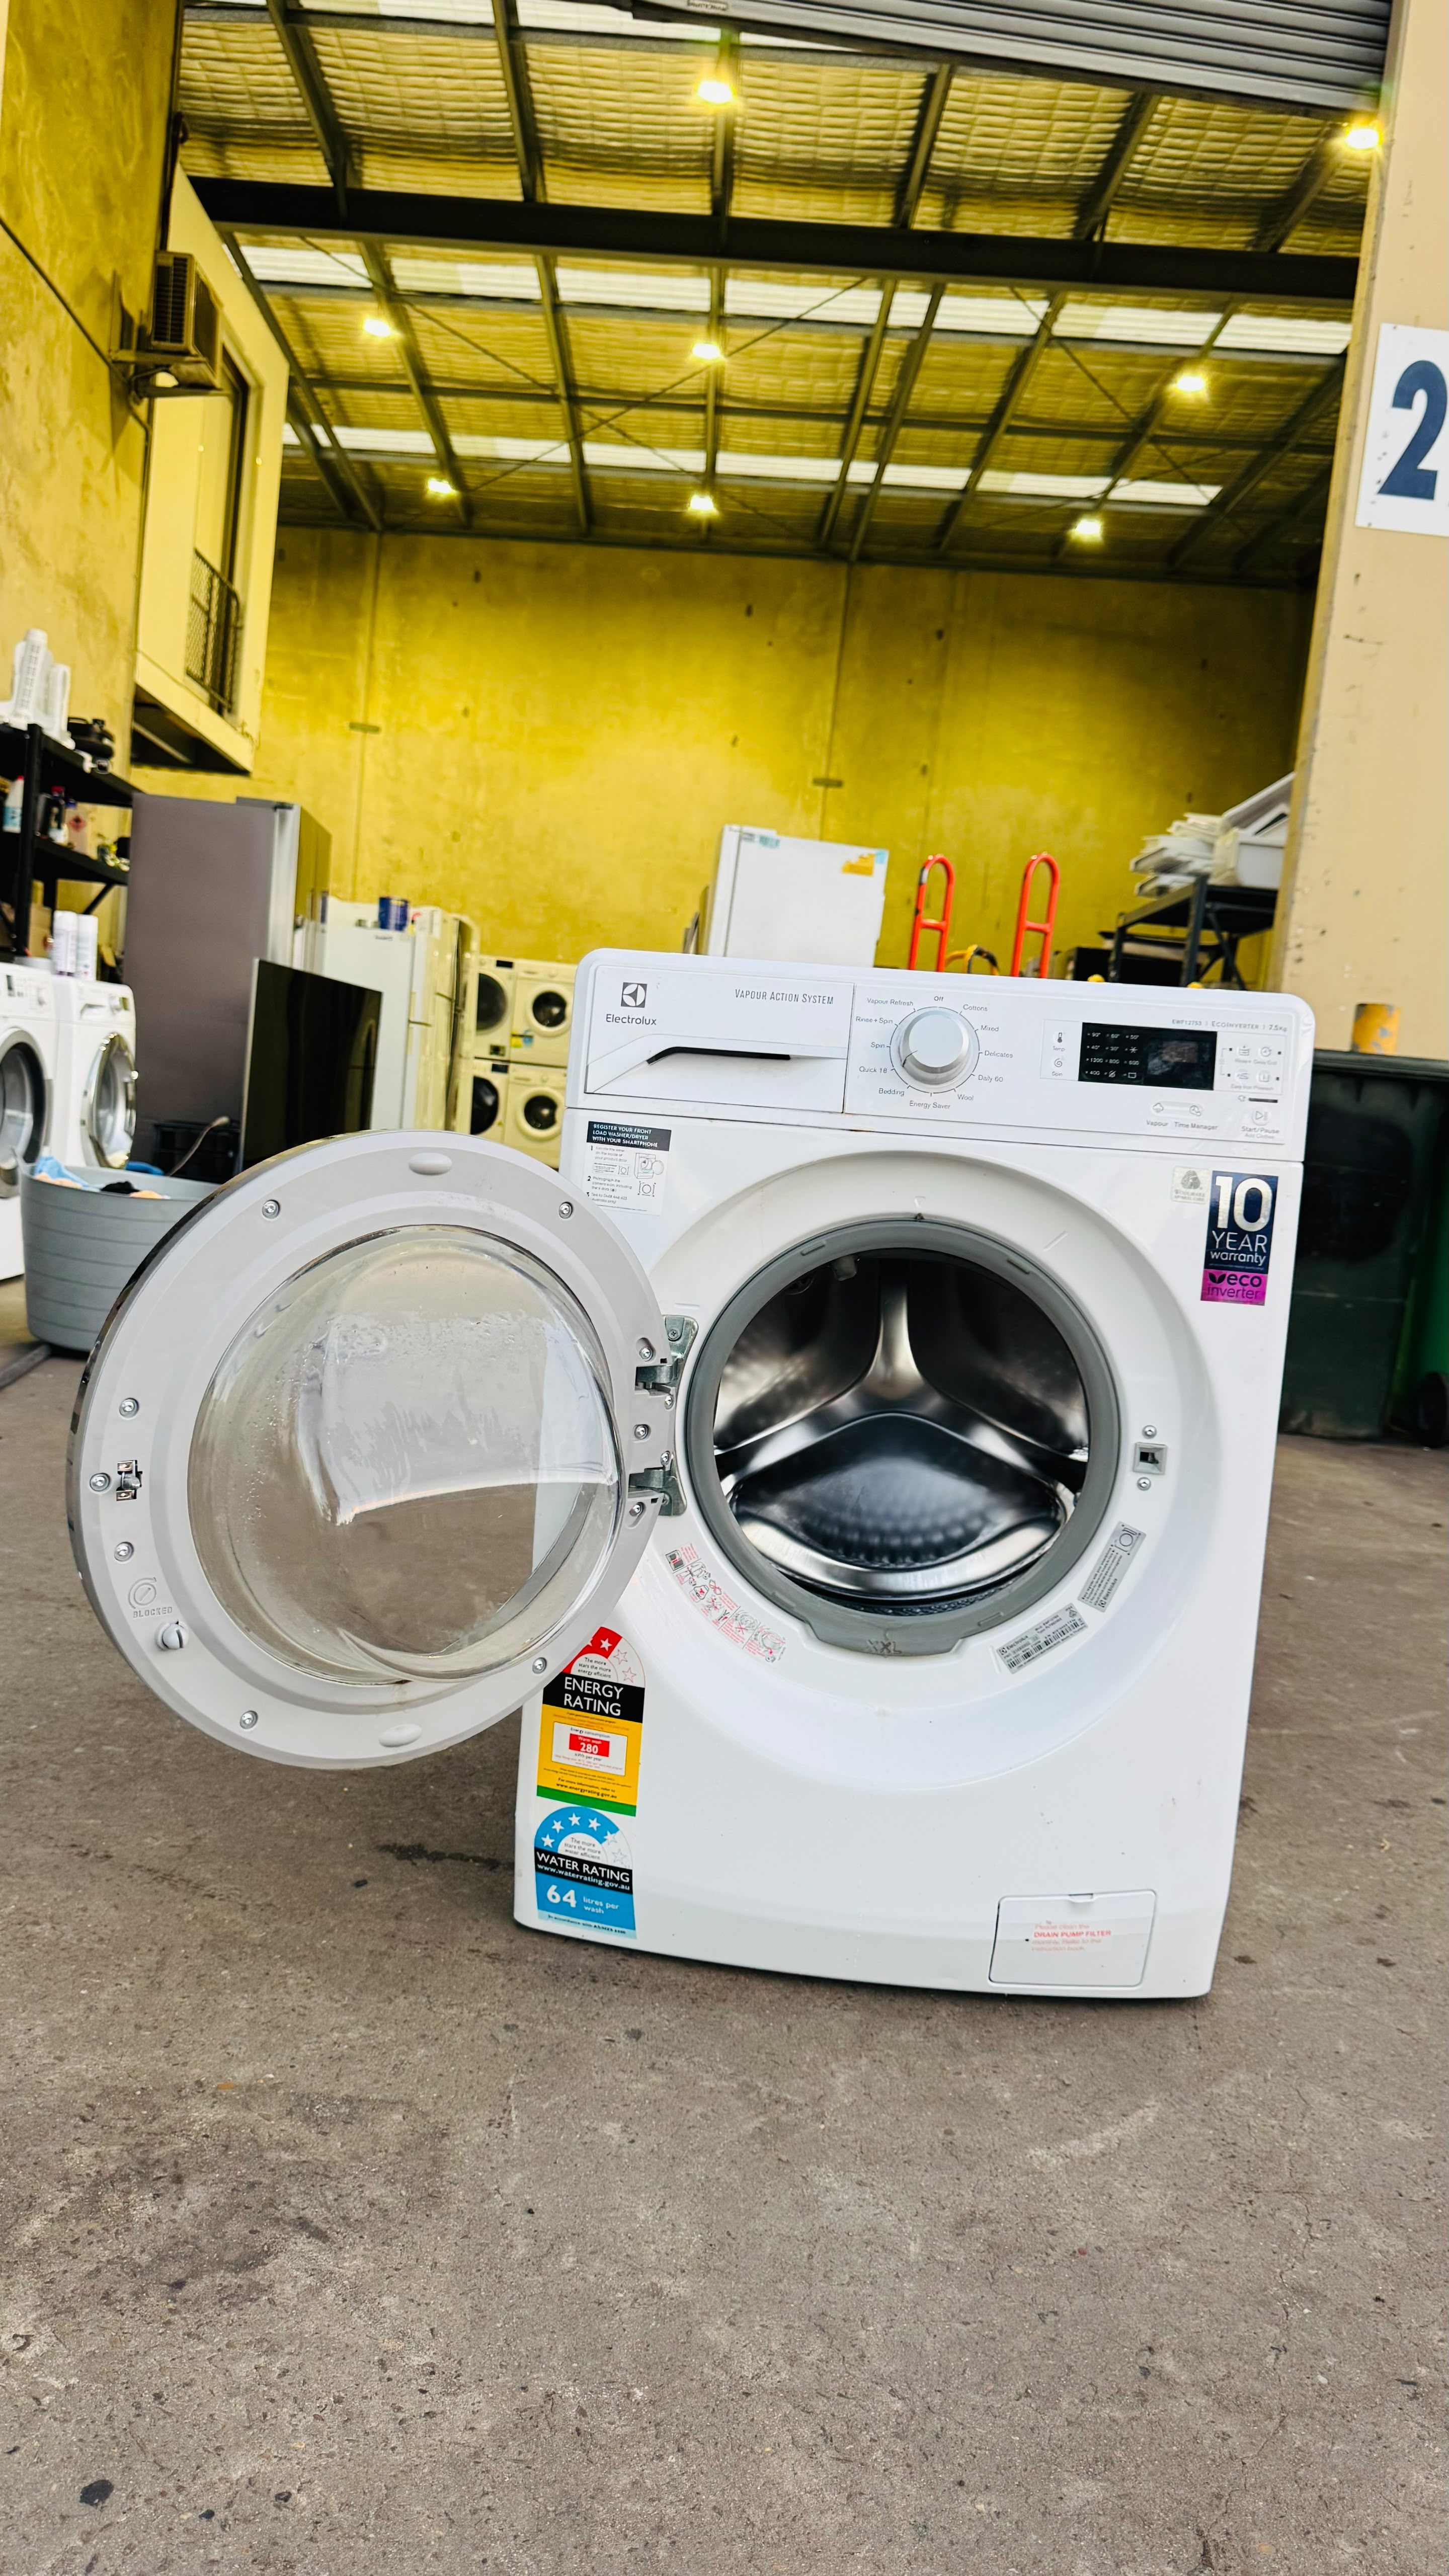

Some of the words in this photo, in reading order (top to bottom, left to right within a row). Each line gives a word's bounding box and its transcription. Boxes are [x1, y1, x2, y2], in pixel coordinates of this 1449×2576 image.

[1378, 360, 1447, 500] 2
[605, 1013, 657, 1025] Electrolux
[978, 1075, 993, 1083] Daily
[878, 1088, 905, 1097] Bedding
[909, 1100, 931, 1109] Energy
[622, 1139, 658, 1148] SMARTPHONE
[1216, 1175, 1272, 1232] 10
[1212, 1230, 1267, 1253] YEAR
[1210, 1251, 1266, 1266] warranty
[1227, 1273, 1262, 1287] eco
[1208, 1284, 1260, 1299] inverter
[133, 1606, 173, 1618] BLOCKED
[565, 1676, 623, 1700] ENERGY
[564, 1693, 621, 1716] RATING
[580, 1742, 599, 1754] 280
[581, 1852, 600, 1860] efficient
[536, 1852, 580, 1872] WATER
[583, 1863, 630, 1883] RATING
[537, 1864, 630, 1890] www.waterrating.gov.au
[547, 1885, 577, 1908] 64
[583, 1896, 603, 1906] litres
[606, 1902, 619, 1910] per
[584, 1905, 604, 1914] wash
